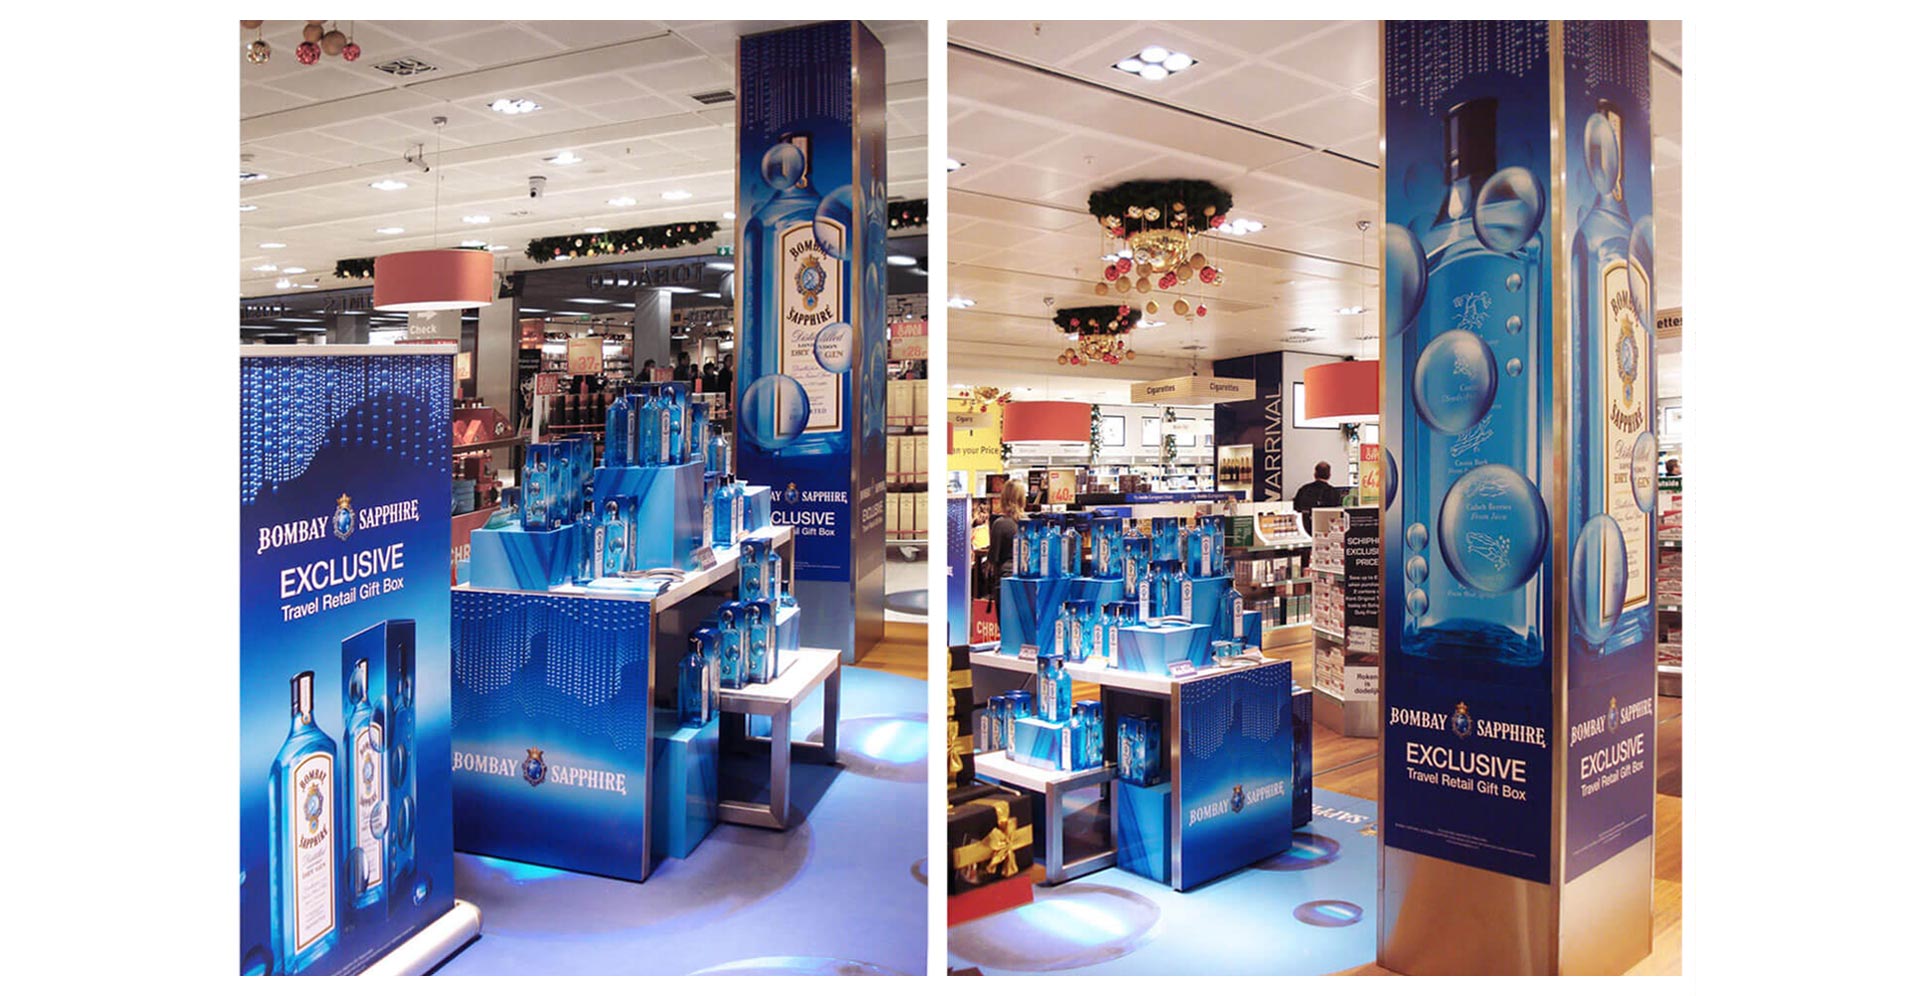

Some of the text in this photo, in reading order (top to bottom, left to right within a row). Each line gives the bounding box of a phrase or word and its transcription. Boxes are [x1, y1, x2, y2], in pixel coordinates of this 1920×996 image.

[410, 324, 437, 335] Check
[786, 304, 834, 326] SAPPHIRE
[1146, 384, 1176, 395] Cigarettes
[1209, 382, 1240, 392] Cigarettes
[962, 447, 980, 456] your
[981, 446, 999, 454] Price
[802, 491, 848, 504] SAPPHIRE
[257, 499, 420, 555] BOMBAY SAPPHIRE
[801, 527, 817, 535] Gift
[818, 528, 835, 536] Box
[280, 543, 404, 599] EXCLUSIVE
[281, 576, 404, 622] Travel Retail Gift Box
[1389, 706, 1547, 749] BOMBAY SAPPHIRE
[1570, 697, 1653, 748] BOMBAY SAPPHIRE
[452, 751, 627, 795] BOMBAY SAPPHIRE
[1406, 742, 1527, 783] EXCLUSIVE
[1580, 733, 1644, 780] EXCLUSIVE
[1406, 767, 1527, 801] Travel Retail Gift Box
[1580, 760, 1644, 798] Travel Retail Gift Box
[1188, 780, 1285, 827] BOMBAY SAPPHIRE
